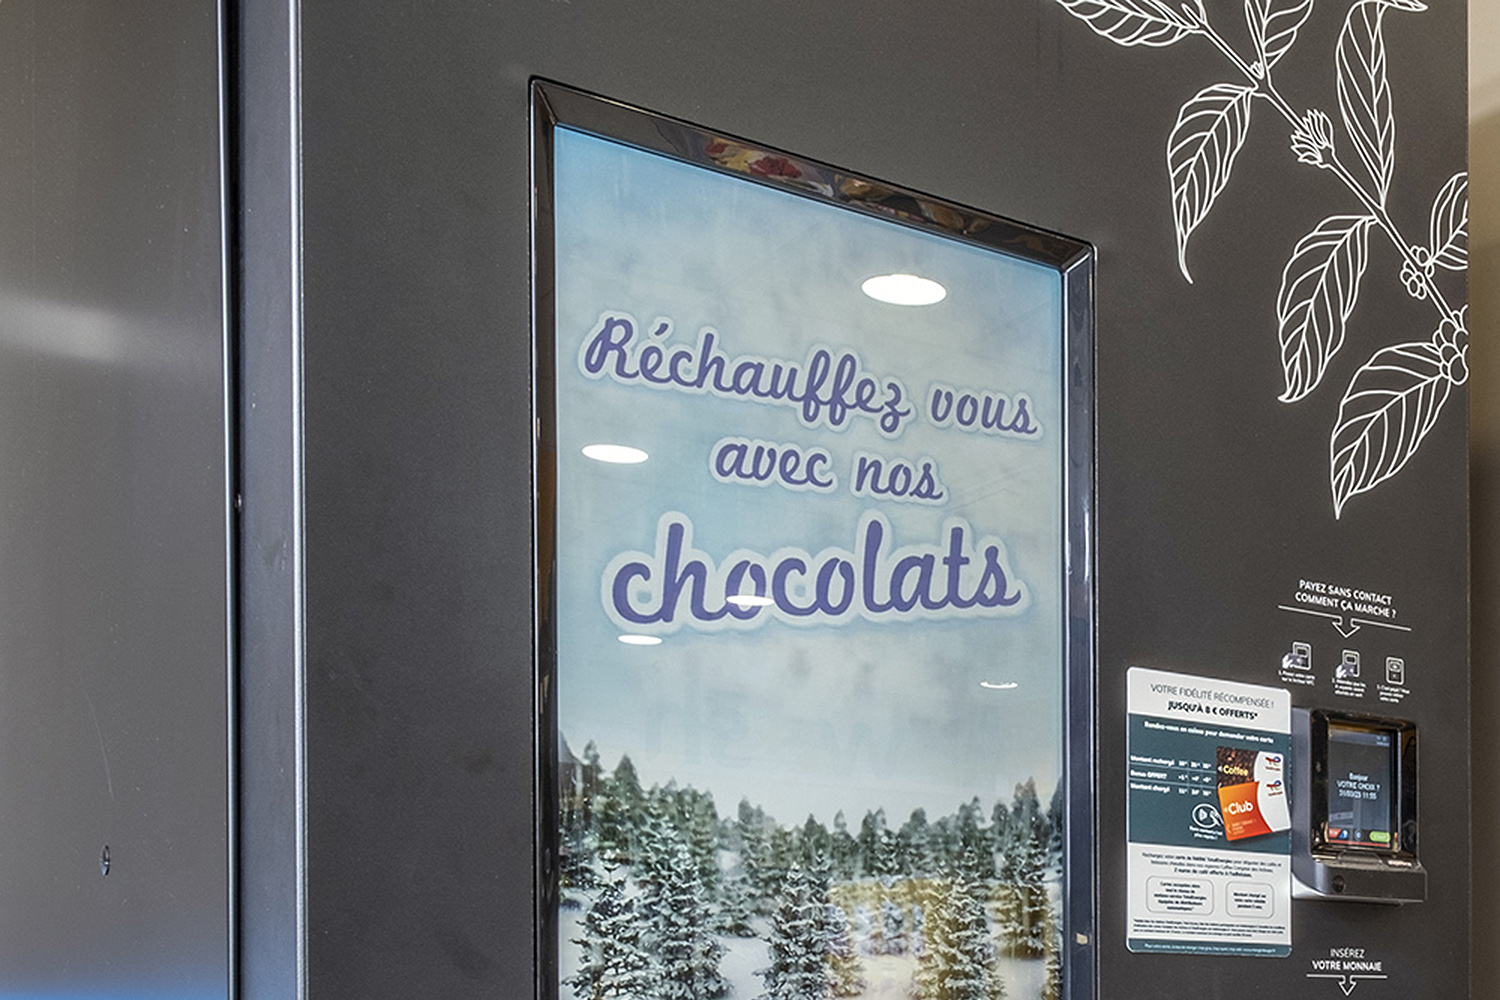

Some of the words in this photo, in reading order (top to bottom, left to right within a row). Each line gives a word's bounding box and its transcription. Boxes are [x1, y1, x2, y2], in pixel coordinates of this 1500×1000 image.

[584, 316, 912, 433] Réchauffez
[930, 385, 1039, 435] vous
[714, 442, 834, 488] avec
[855, 456, 943, 501] nos
[611, 519, 1022, 624] chocolats
[1294, 591, 1339, 608] COMMENT
[1340, 599, 1353, 612] ÇA
[1354, 603, 1390, 618] MARCHE
[1299, 579, 1327, 594] PAYEZ
[1328, 584, 1352, 599] SANS
[1353, 589, 1392, 606] CONTACT
[1150, 683, 1178, 697] VOTRE
[1179, 686, 1213, 701] FIDÉLITÉ
[1213, 691, 1270, 709] RÉCOMPENSÉE
[1167, 700, 1205, 713] JUSQU'À
[1144, 720, 1180, 733] Rendez-vous
[1188, 726, 1205, 736] caisse
[1205, 729, 1218, 738] pour
[1218, 730, 1245, 742] demander
[1246, 734, 1260, 744] votre
[1260, 735, 1274, 744] carte
[1222, 764, 1249, 776] Coffee
[1336, 779, 1357, 790] VOTRE
[1228, 800, 1254, 815] Club
[1330, 948, 1365, 959] INSÉREZ
[1312, 960, 1341, 971] VOTRE
[1342, 961, 1382, 972] MONNAIE
